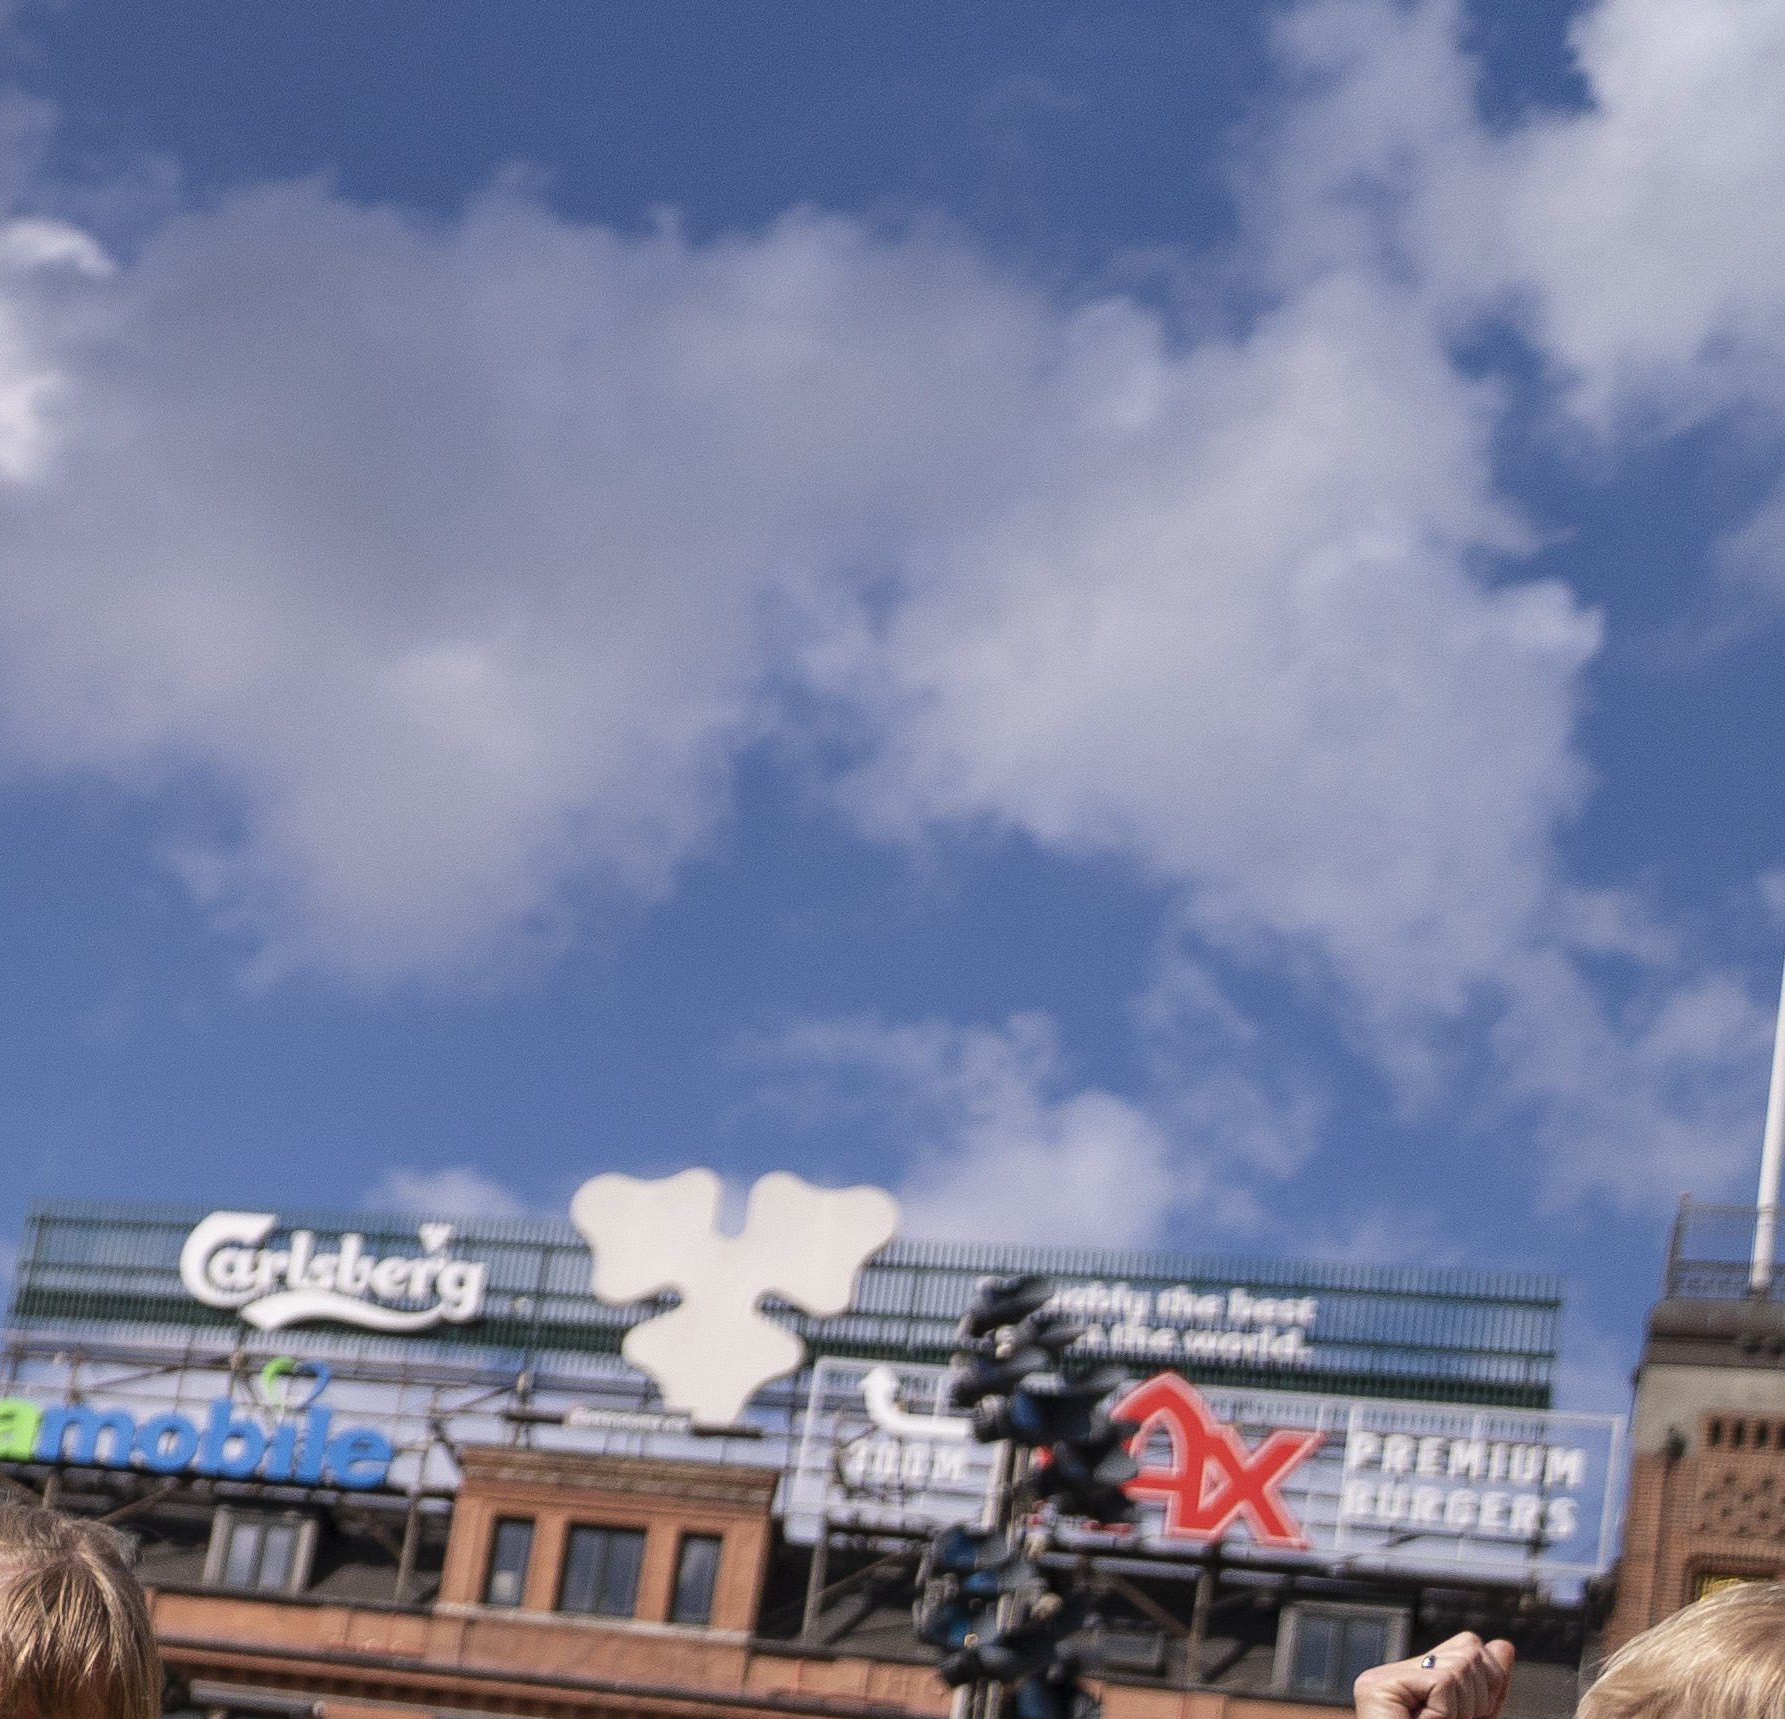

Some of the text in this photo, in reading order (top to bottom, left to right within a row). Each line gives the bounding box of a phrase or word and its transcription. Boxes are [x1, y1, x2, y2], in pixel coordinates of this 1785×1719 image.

[180, 1210, 487, 1331] Carlsberg
[1109, 1369, 1325, 1550] AX
[1345, 1431, 1588, 1489] PREMIUM
[1343, 1478, 1582, 1541] BURGERS
